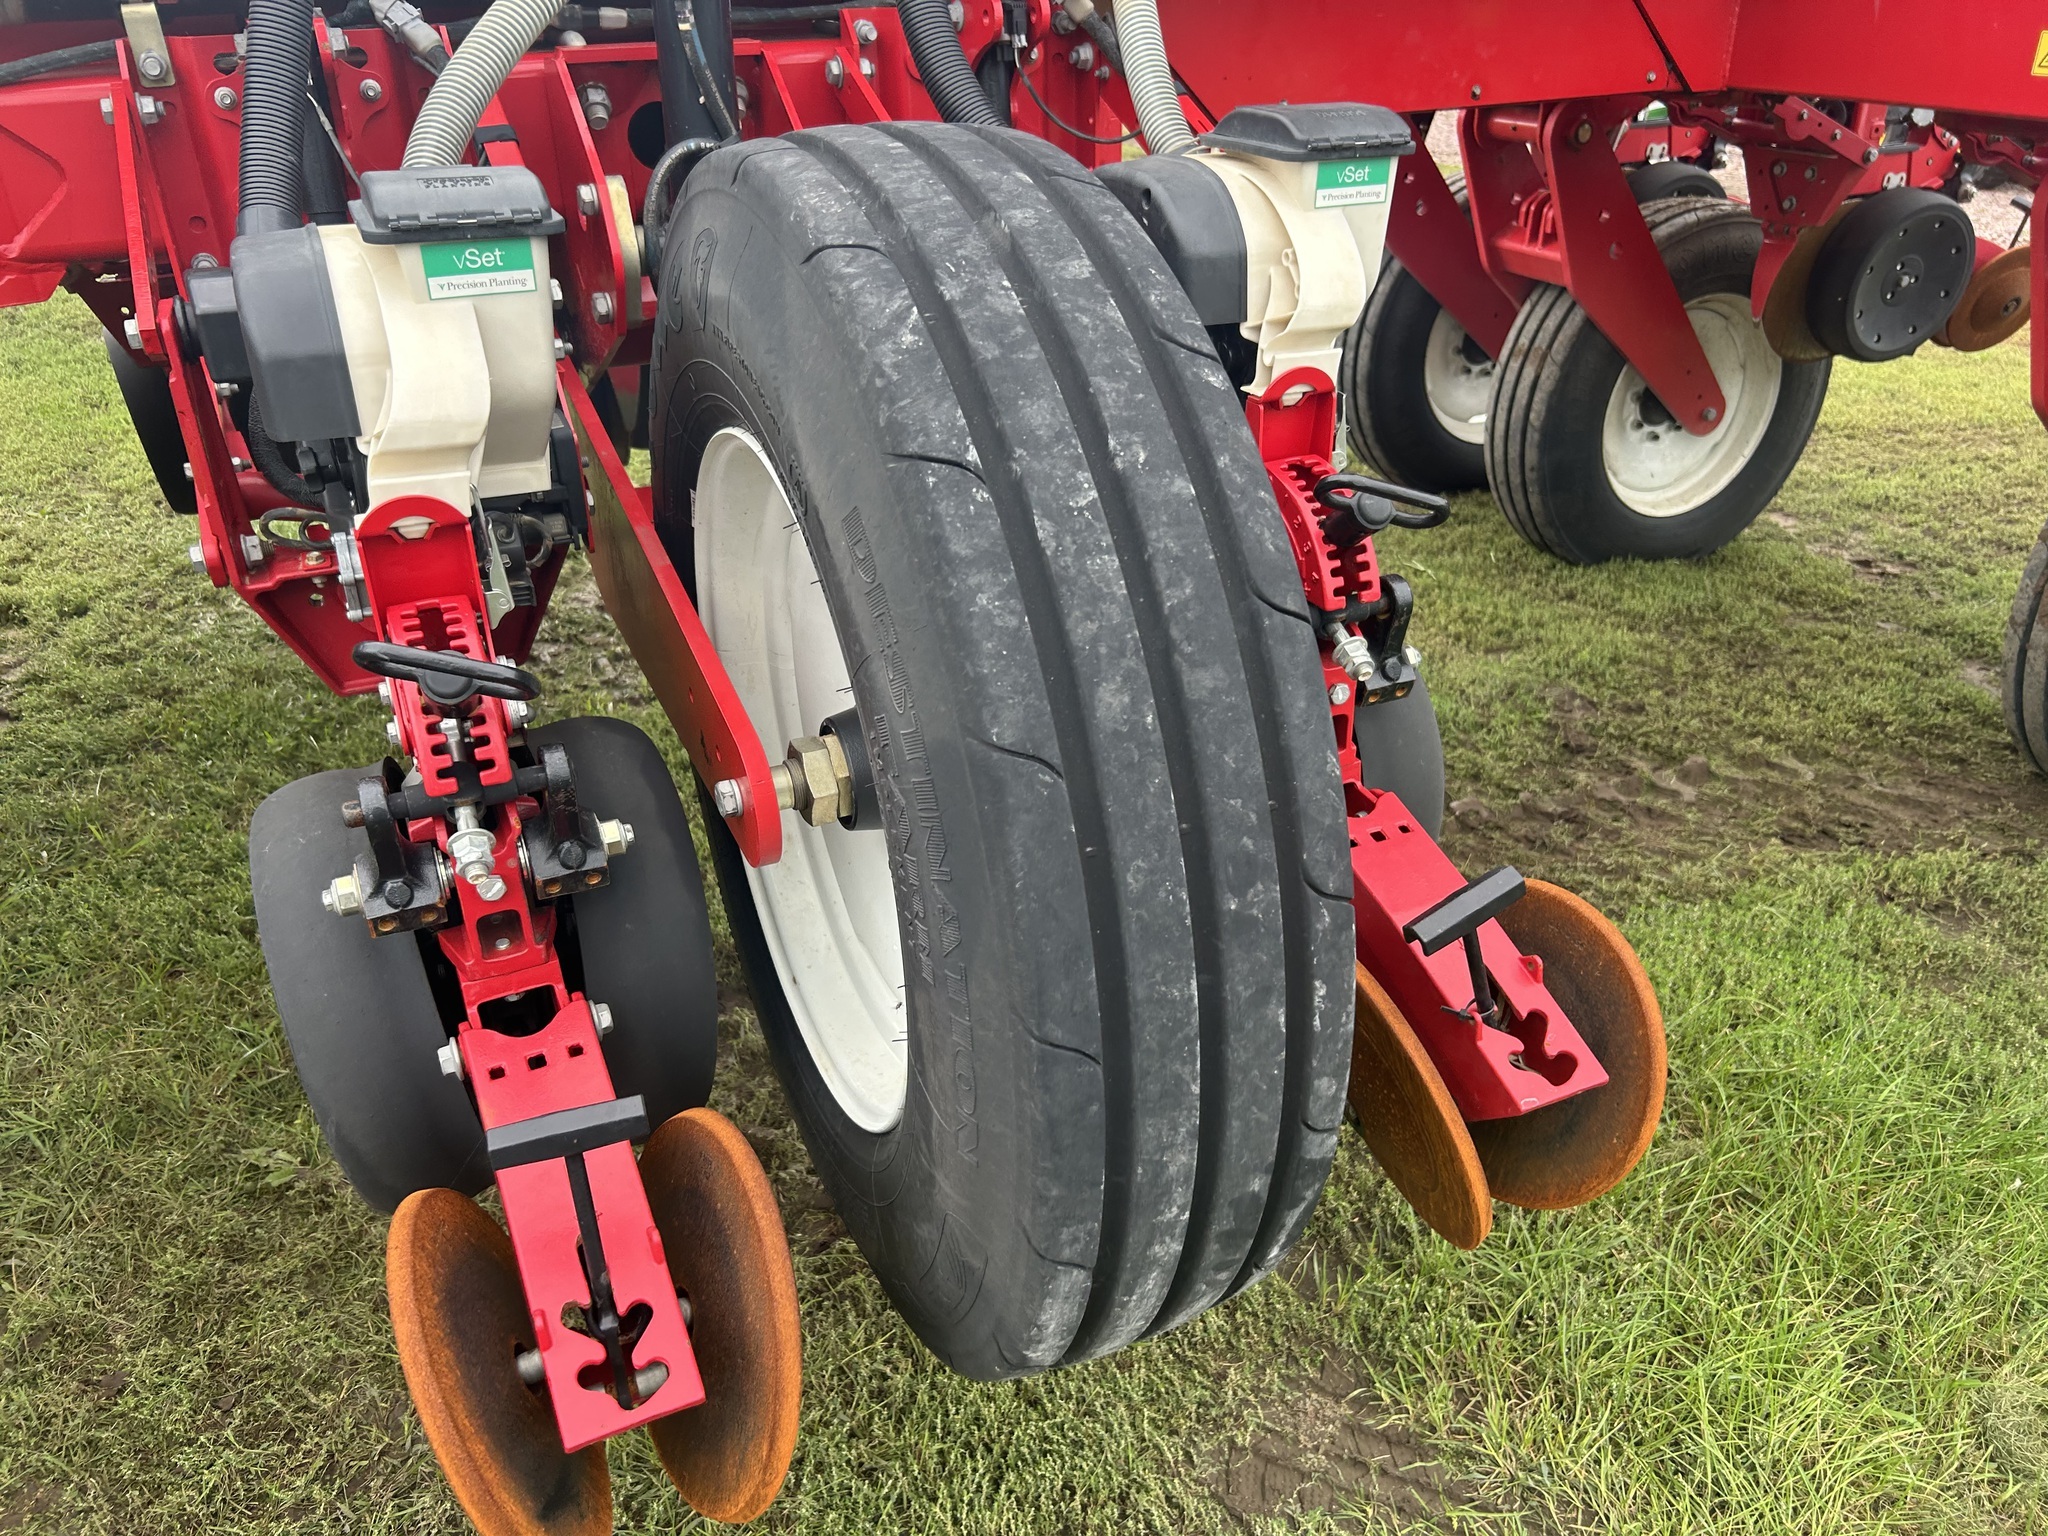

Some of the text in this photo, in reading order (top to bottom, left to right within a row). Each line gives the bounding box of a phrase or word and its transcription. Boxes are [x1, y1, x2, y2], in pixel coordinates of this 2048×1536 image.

[1337, 165, 1370, 183] vSet
[1327, 190, 1381, 201] Precision Planting
[452, 247, 505, 269] vSet
[447, 276, 527, 291] Precision Planting
[842, 506, 979, 1167] DESTINATION
